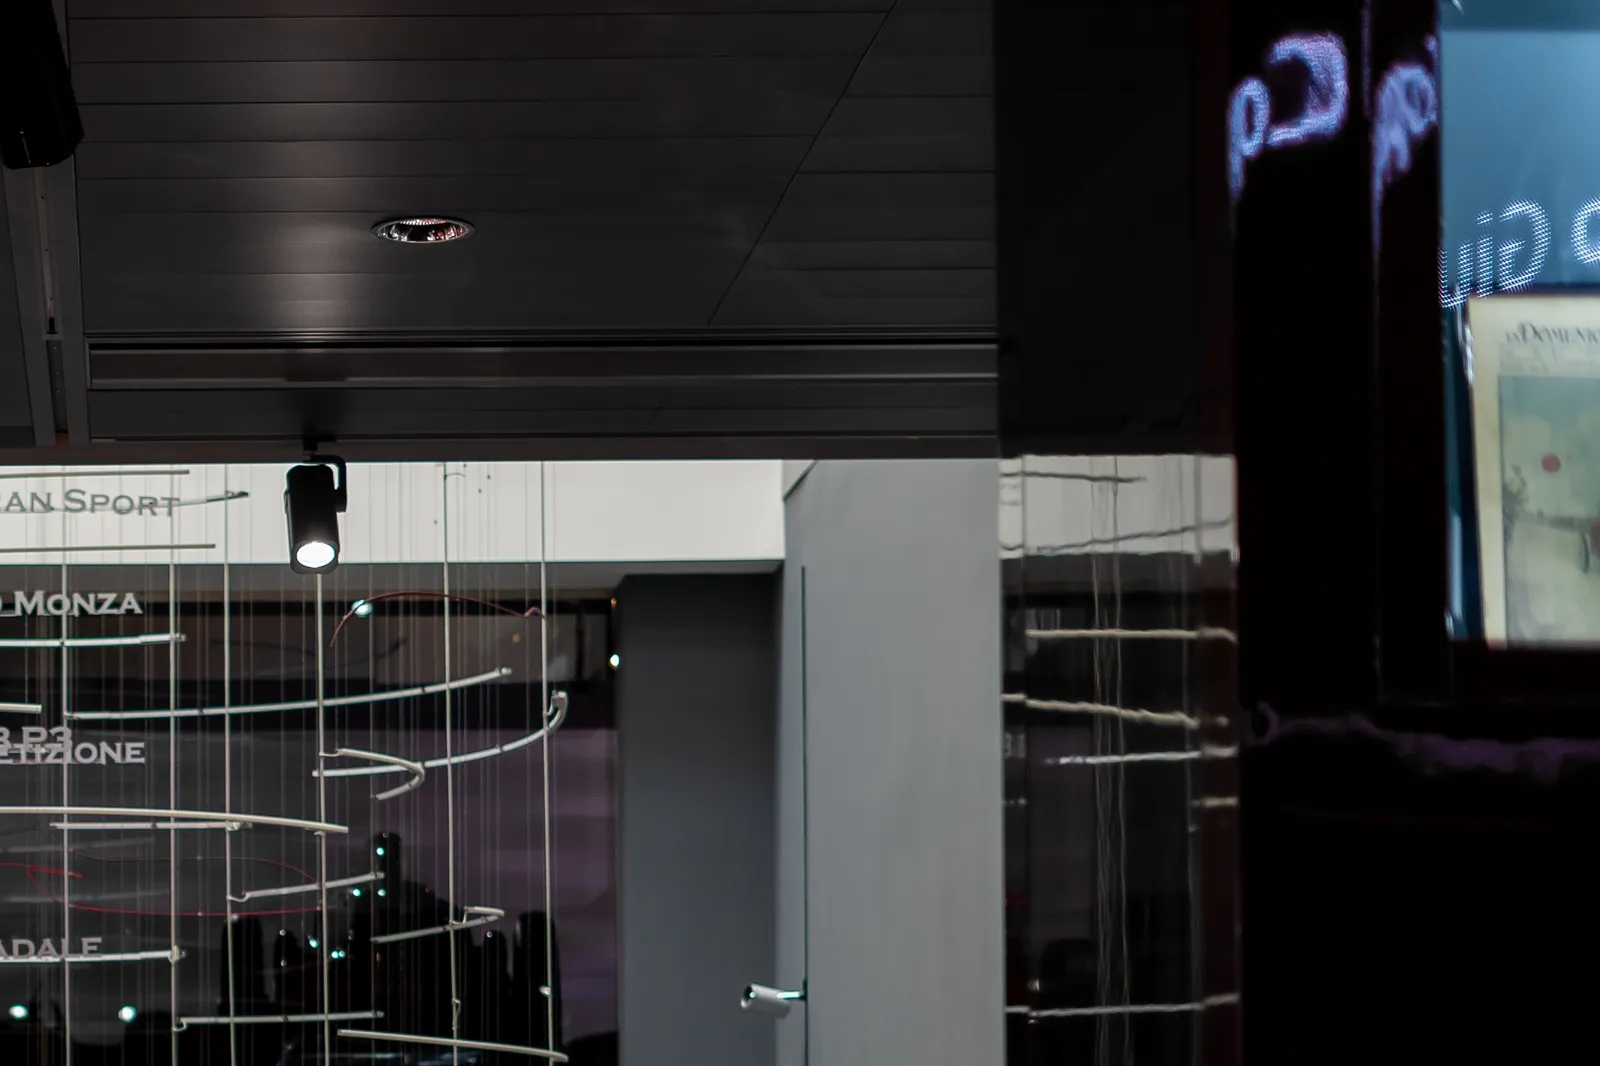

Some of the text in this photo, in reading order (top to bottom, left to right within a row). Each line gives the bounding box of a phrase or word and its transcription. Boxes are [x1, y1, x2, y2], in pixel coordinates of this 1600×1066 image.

[63, 489, 180, 517] SPORT
[14, 590, 143, 617] MONZA
[22, 726, 72, 752] P3
